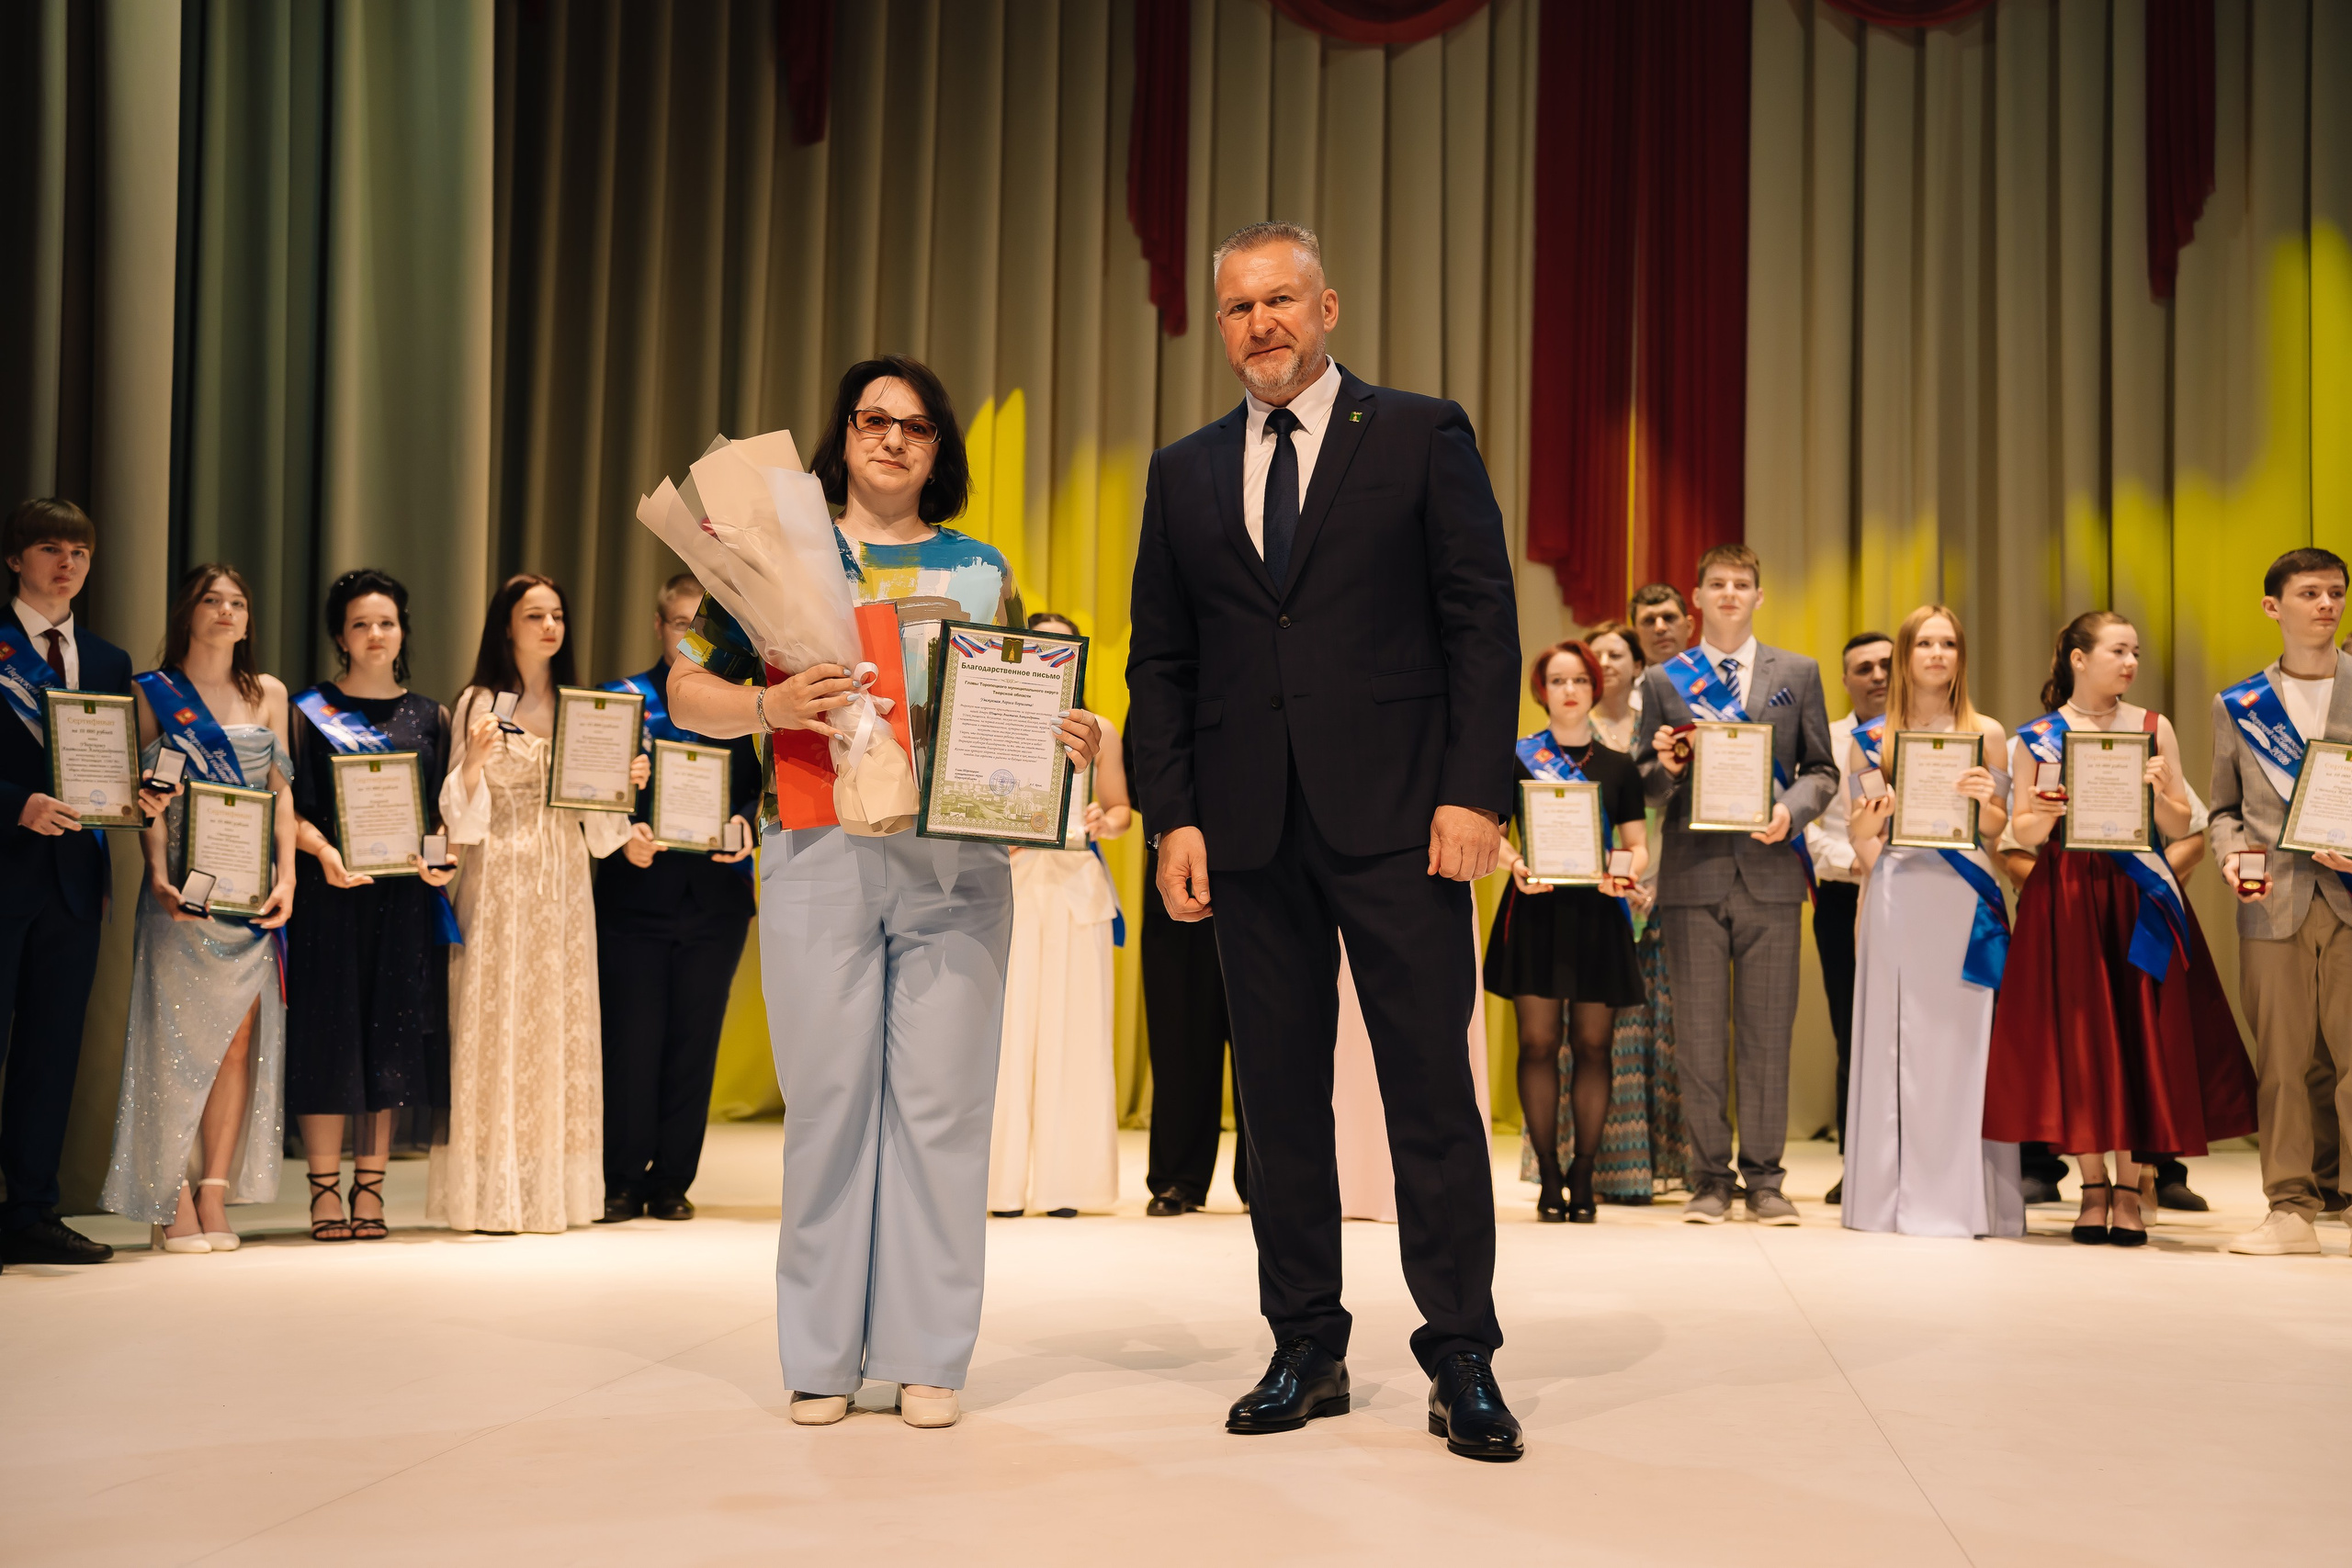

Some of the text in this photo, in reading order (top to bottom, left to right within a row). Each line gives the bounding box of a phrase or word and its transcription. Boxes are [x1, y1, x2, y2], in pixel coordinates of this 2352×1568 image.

[961, 661, 1060, 680] Благодарственное письмо
[979, 682, 1007, 690] Торопецкого
[1007, 685, 1044, 694] муниципального
[67, 716, 115, 726] Сертификат
